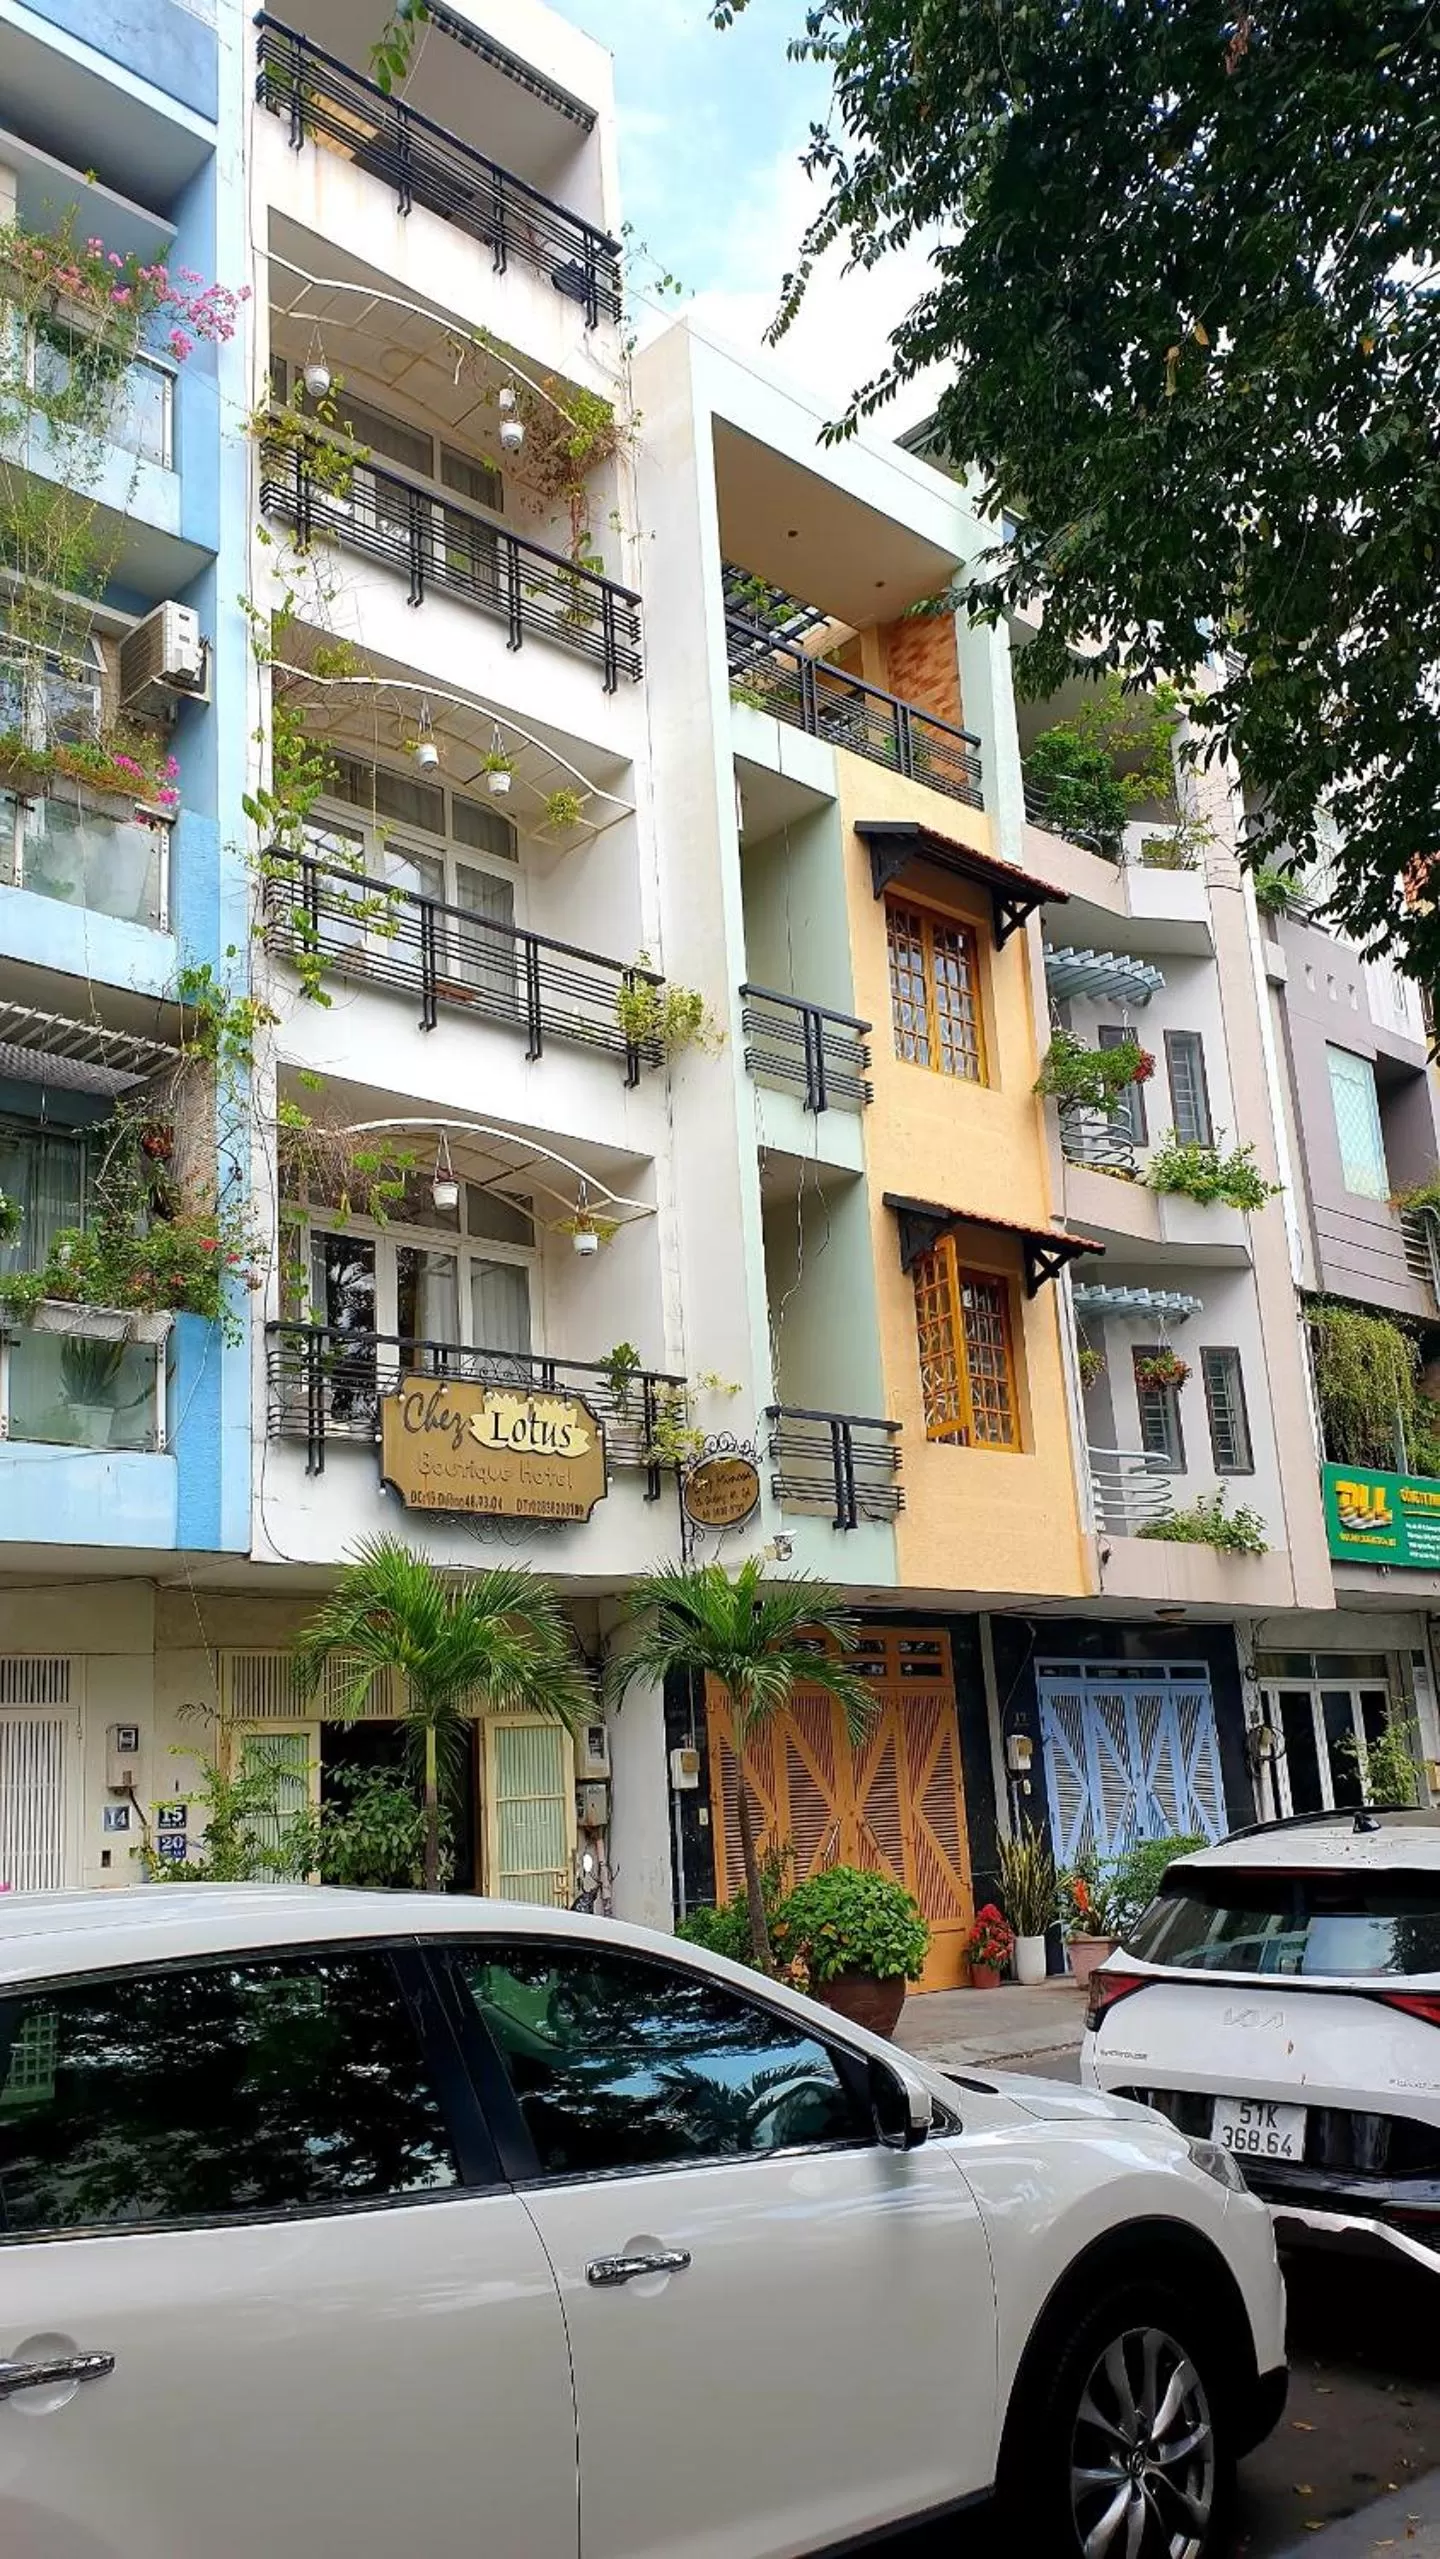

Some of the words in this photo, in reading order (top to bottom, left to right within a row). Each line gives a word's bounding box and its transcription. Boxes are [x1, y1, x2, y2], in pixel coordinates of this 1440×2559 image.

[403, 1390, 471, 1450] Chez
[490, 1410, 573, 1448] Lotus
[108, 1811, 126, 1826] 14
[161, 1806, 184, 1823] 15
[161, 1836, 184, 1851] 20
[1239, 2102, 1279, 2129] 51K
[1221, 2124, 1293, 2157] 368.64
